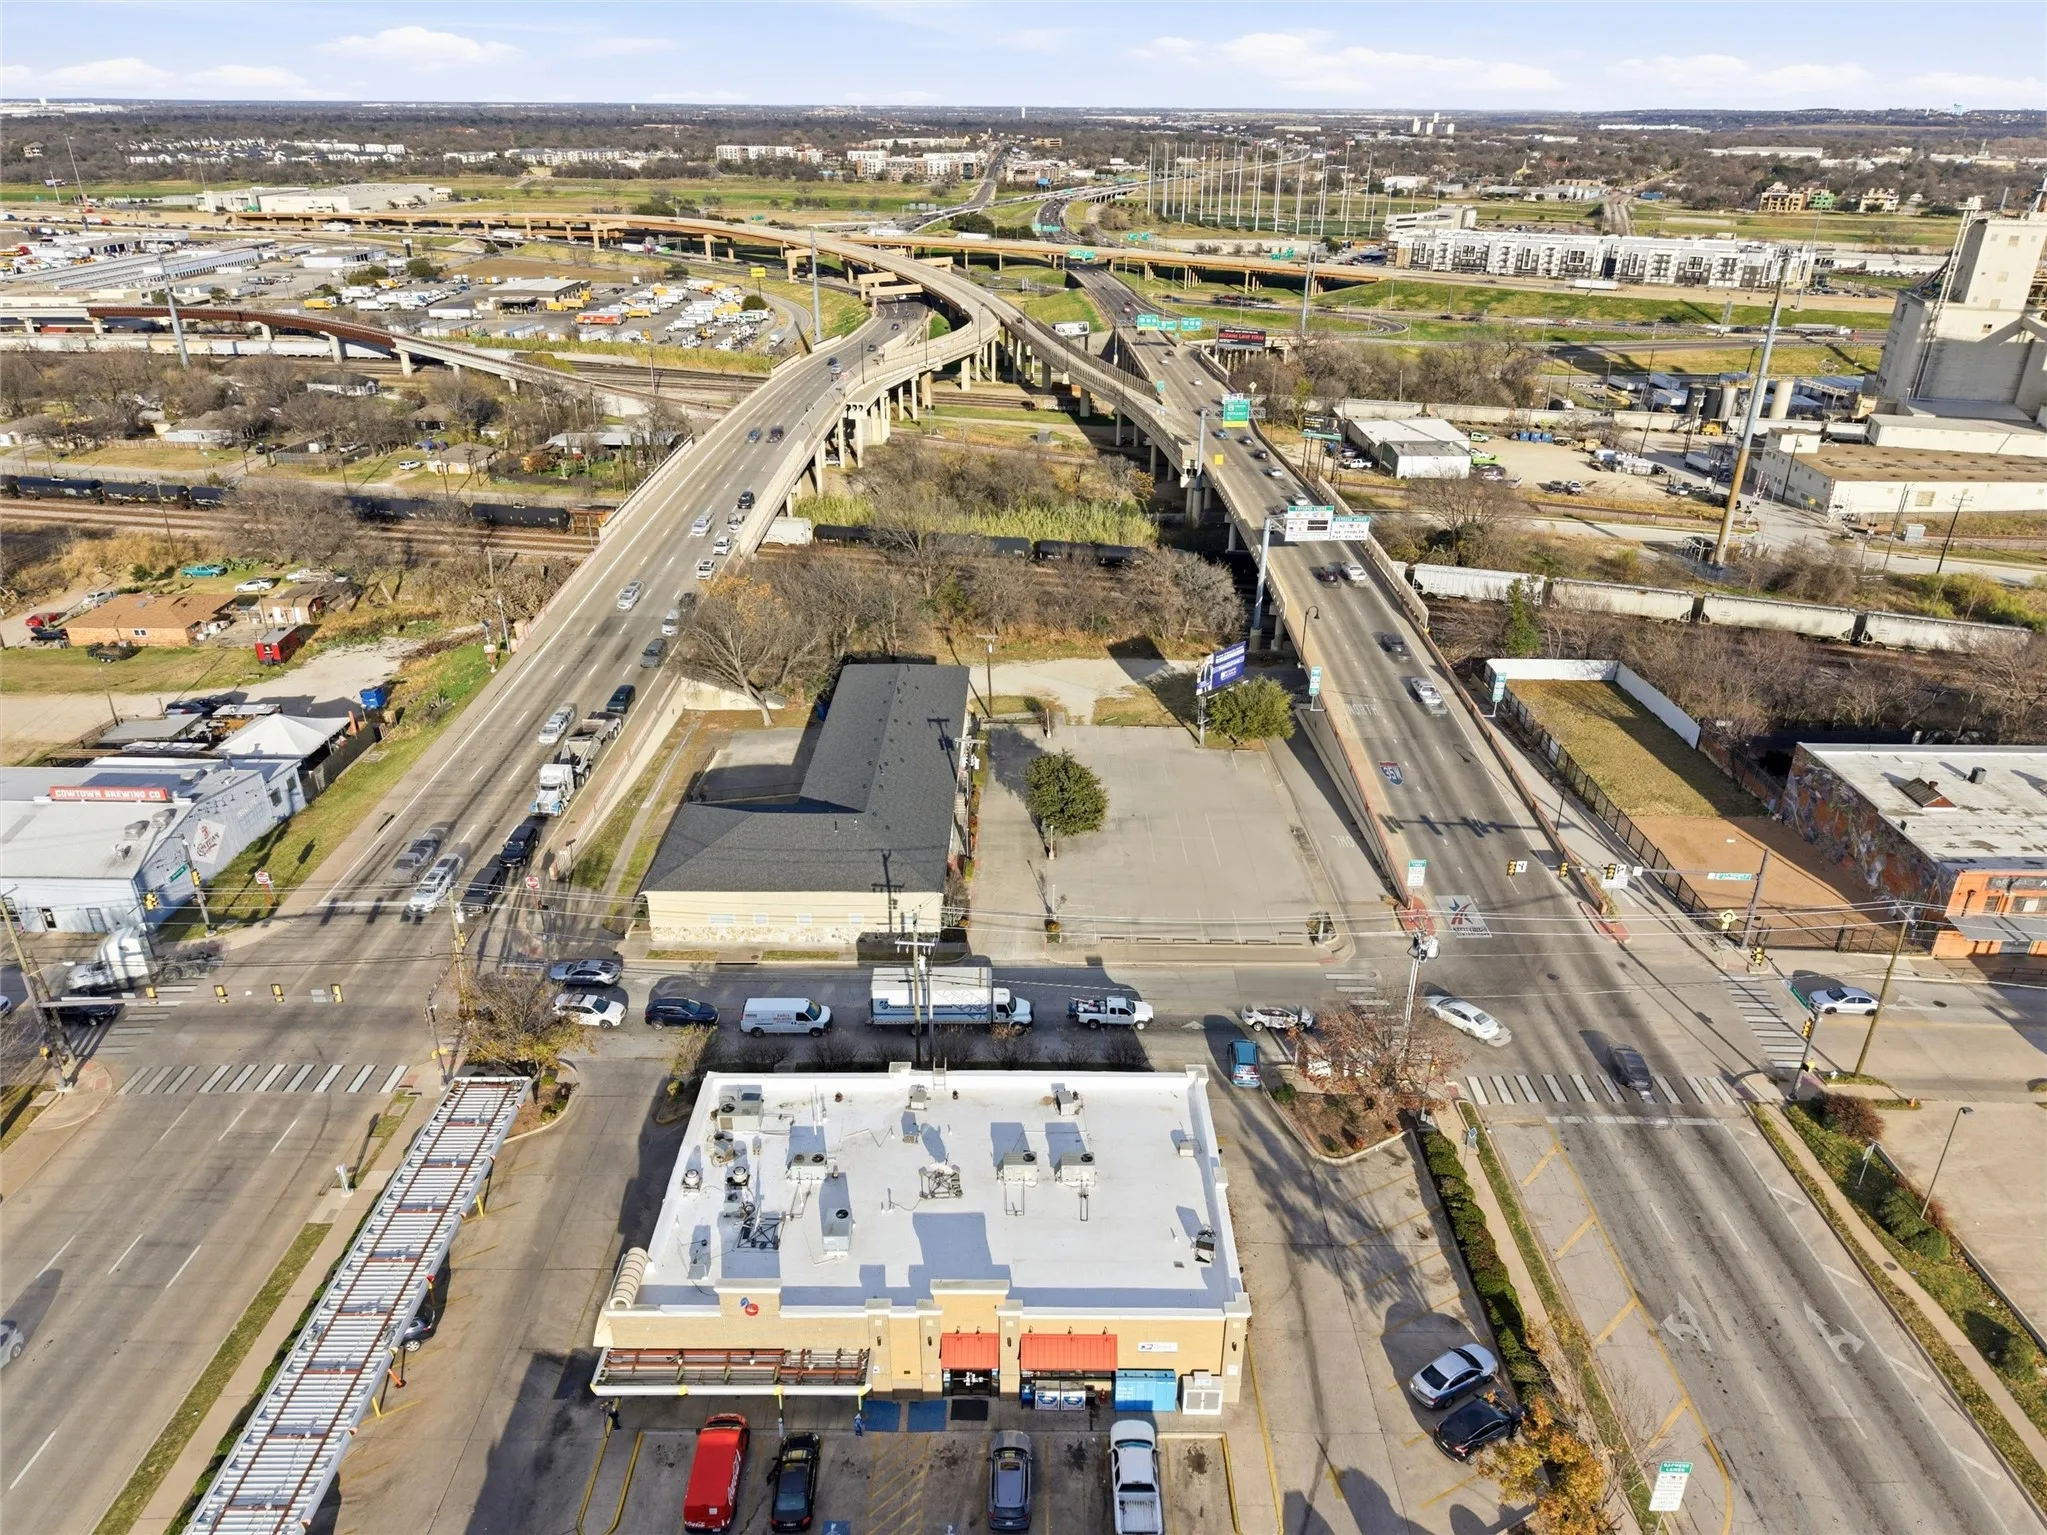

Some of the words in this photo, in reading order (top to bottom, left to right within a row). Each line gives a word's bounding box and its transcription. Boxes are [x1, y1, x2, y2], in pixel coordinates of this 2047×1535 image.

[1346, 703, 1380, 716] NORTH
[1383, 766, 1402, 780] 35W
[55, 789, 102, 798] COWTOWN
[104, 790, 146, 799] BREWING
[149, 791, 161, 799] CO
